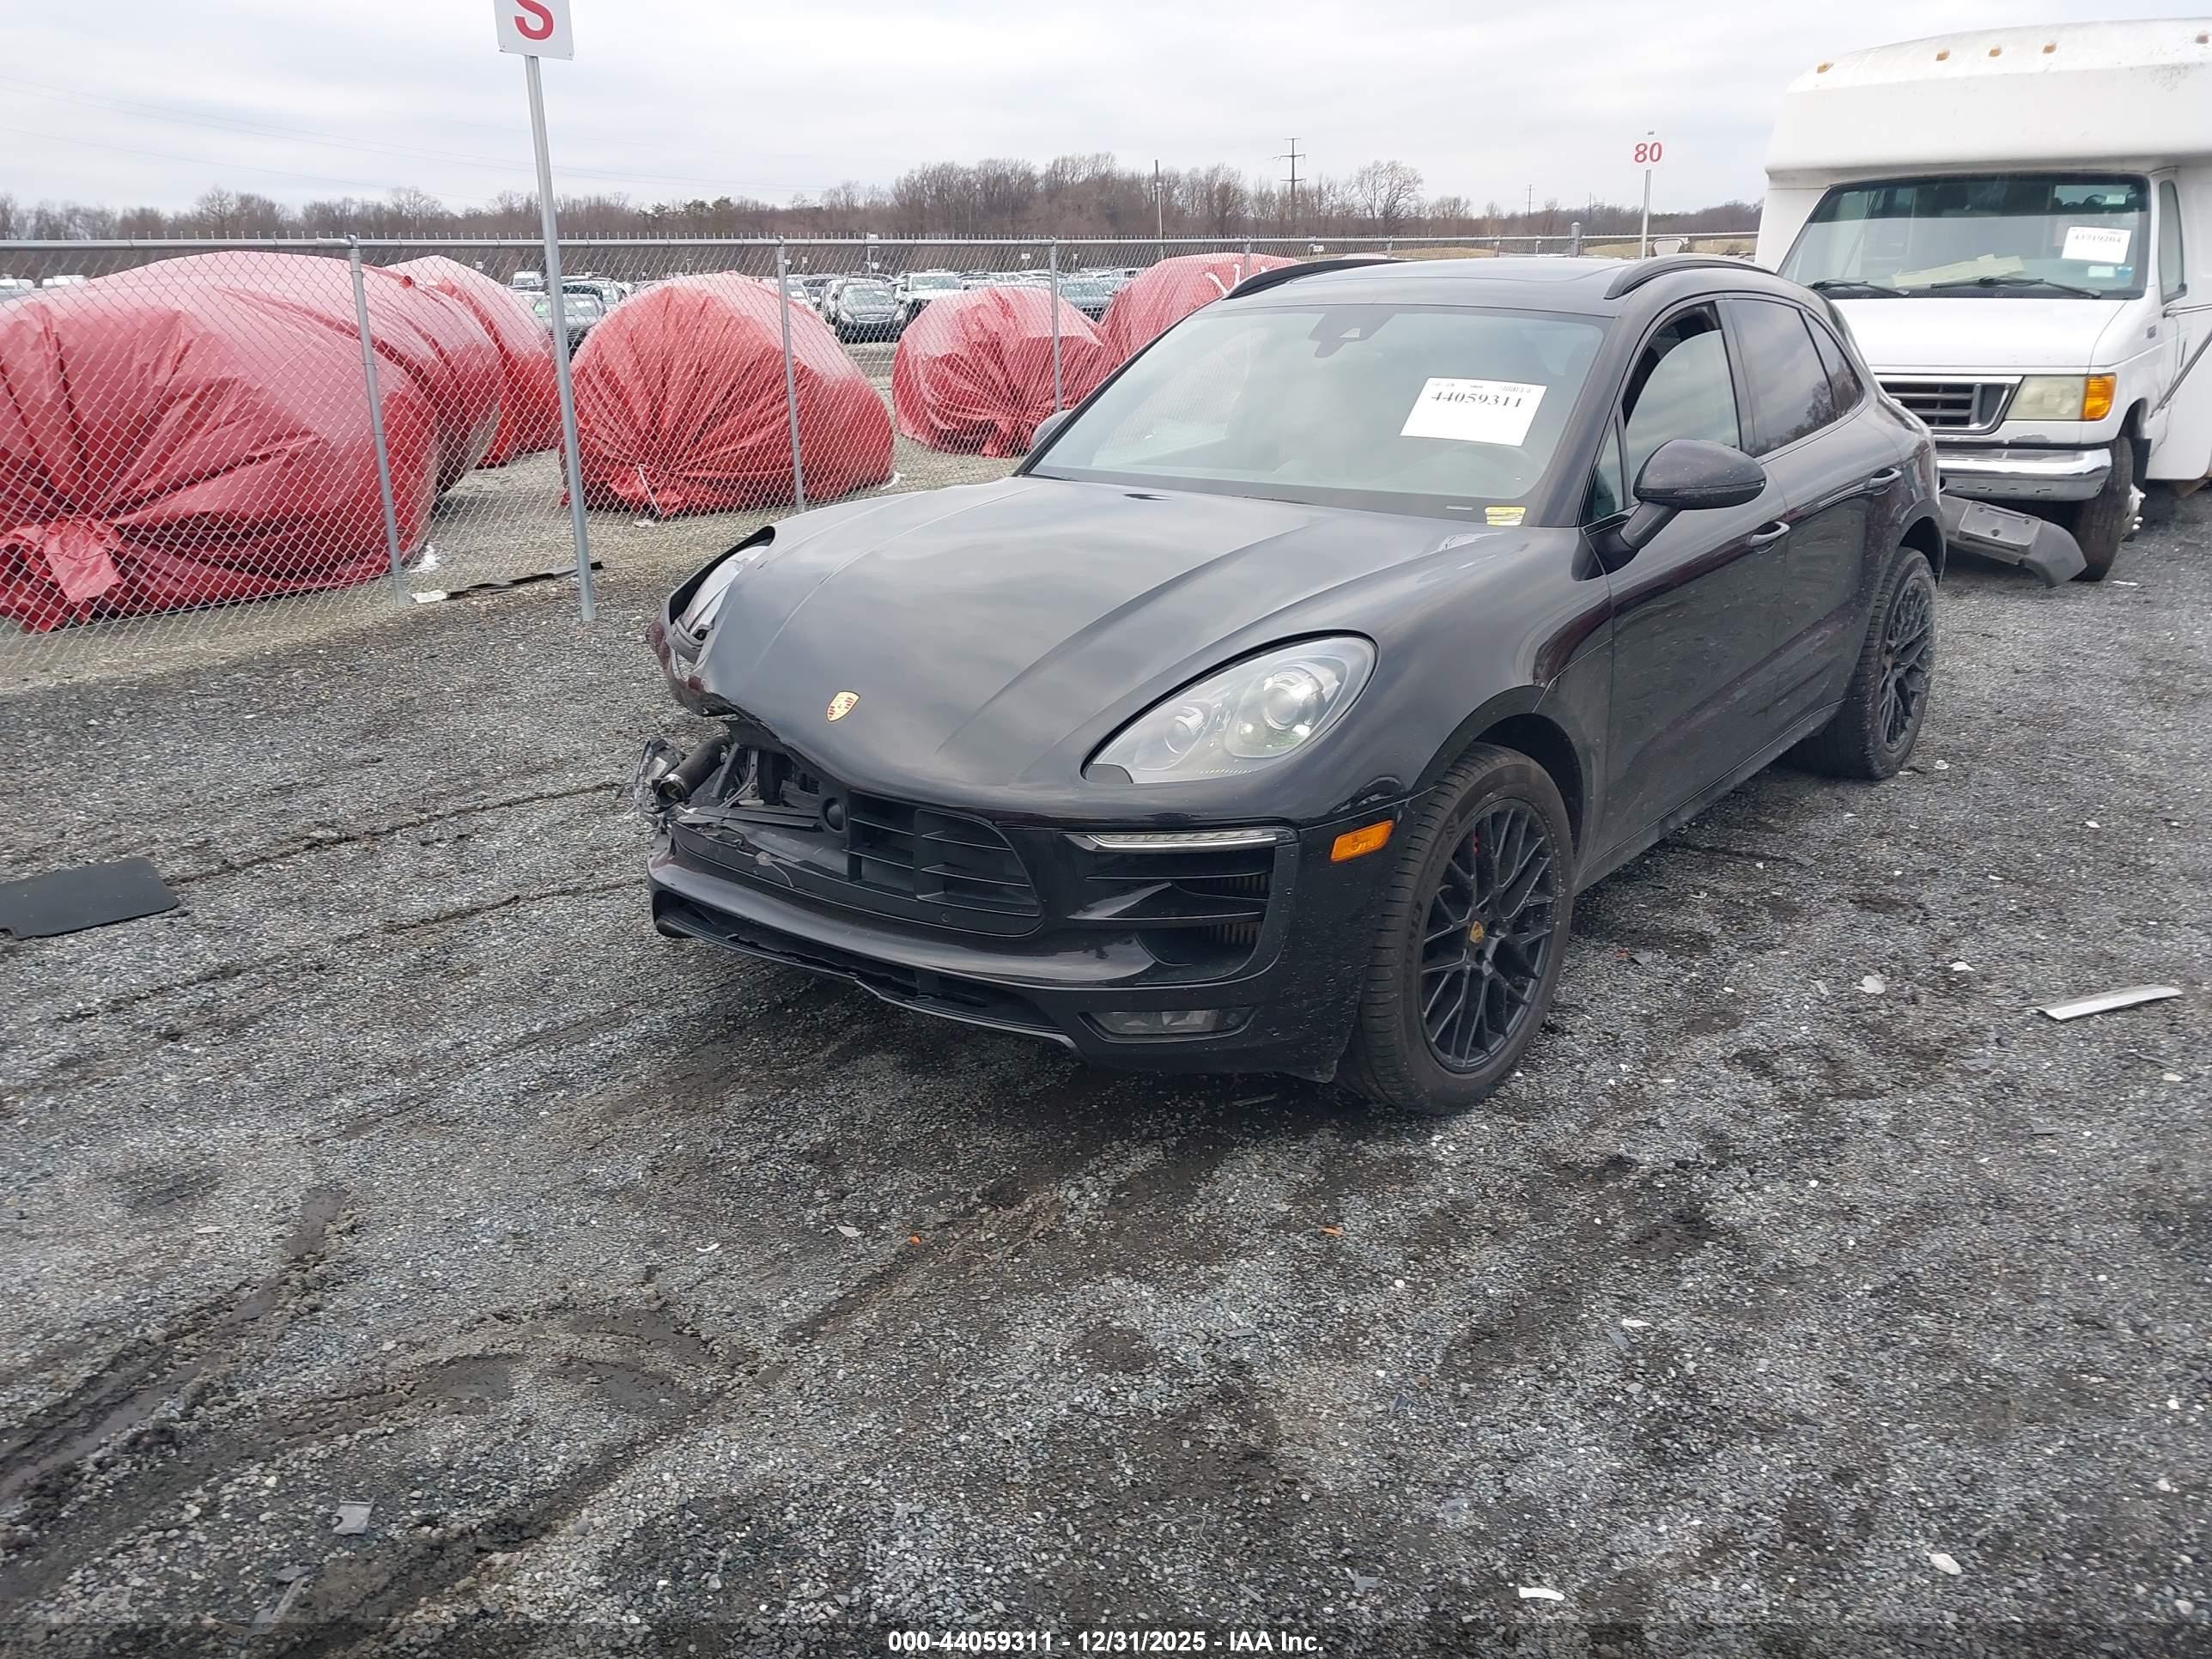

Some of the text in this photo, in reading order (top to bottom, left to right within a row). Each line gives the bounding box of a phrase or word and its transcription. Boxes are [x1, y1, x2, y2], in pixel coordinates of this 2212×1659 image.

[514, 0, 554, 40] S
[1634, 142, 1662, 163] 80
[1431, 391, 1522, 408] 44059311
